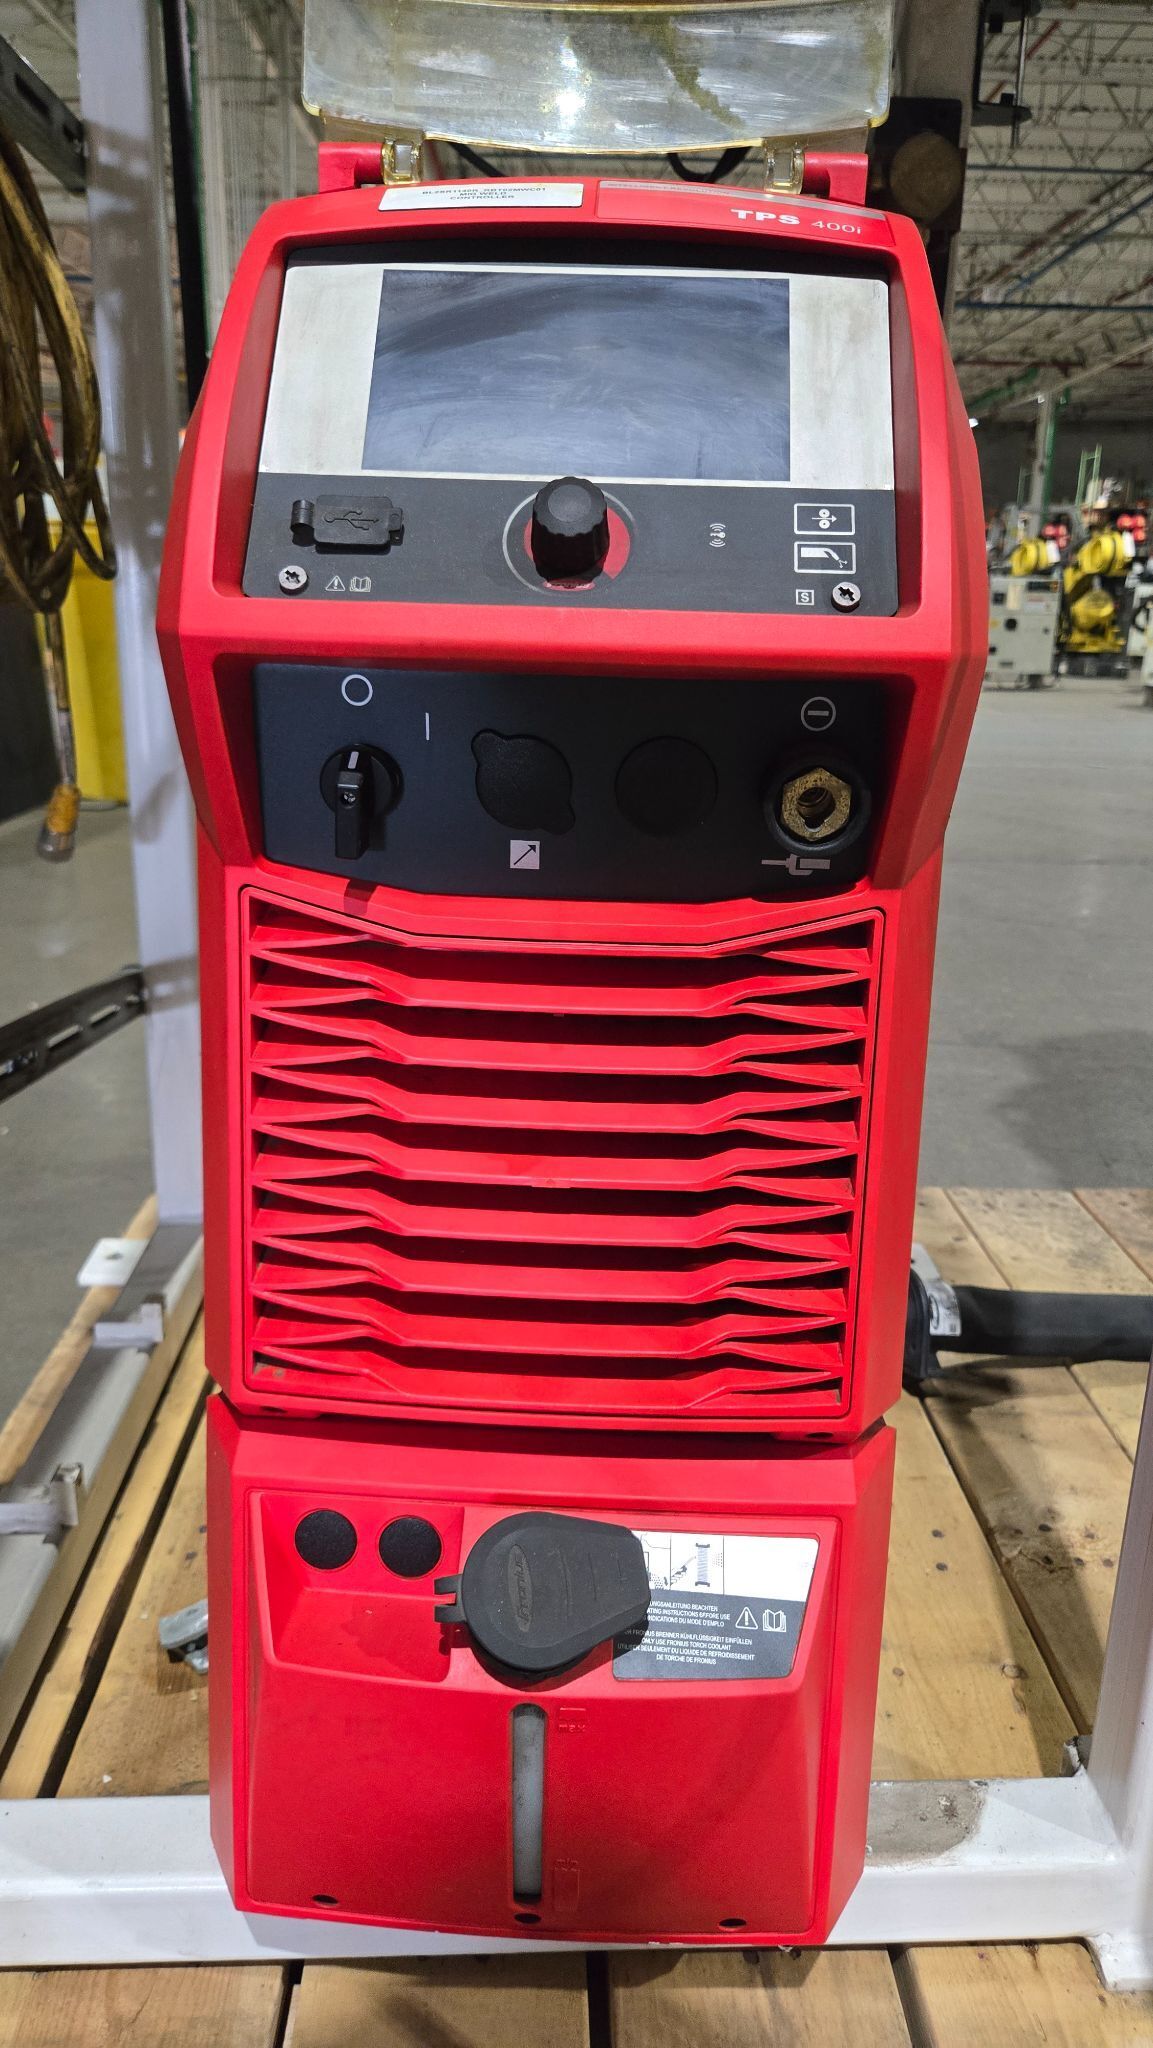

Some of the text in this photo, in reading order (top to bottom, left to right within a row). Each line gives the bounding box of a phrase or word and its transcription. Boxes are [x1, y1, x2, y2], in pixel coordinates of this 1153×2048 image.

[730, 209, 862, 235] TPS 400i
[662, 1609, 698, 1619] INSTRUCTIONS
[720, 1613, 730, 1621] USE
[691, 1604, 718, 1612] BEACHTEN
[641, 1637, 654, 1645] ONLY
[666, 1639, 689, 1648] FRONIUS
[690, 1641, 707, 1649] TORCH
[707, 1643, 731, 1651] COOLANT
[655, 1631, 680, 1639] BRENNER
[725, 1636, 753, 1646] EINFÜLLEN
[640, 1644, 671, 1653] SEULEMENT
[680, 1648, 699, 1656] LIQUIDE
[700, 1649, 708, 1657] DE
[708, 1650, 755, 1661] REFROIDISSEMENT
[656, 1653, 664, 1661] DE
[664, 1654, 685, 1663] TORCHE
[694, 1656, 717, 1665] FRONIUS
